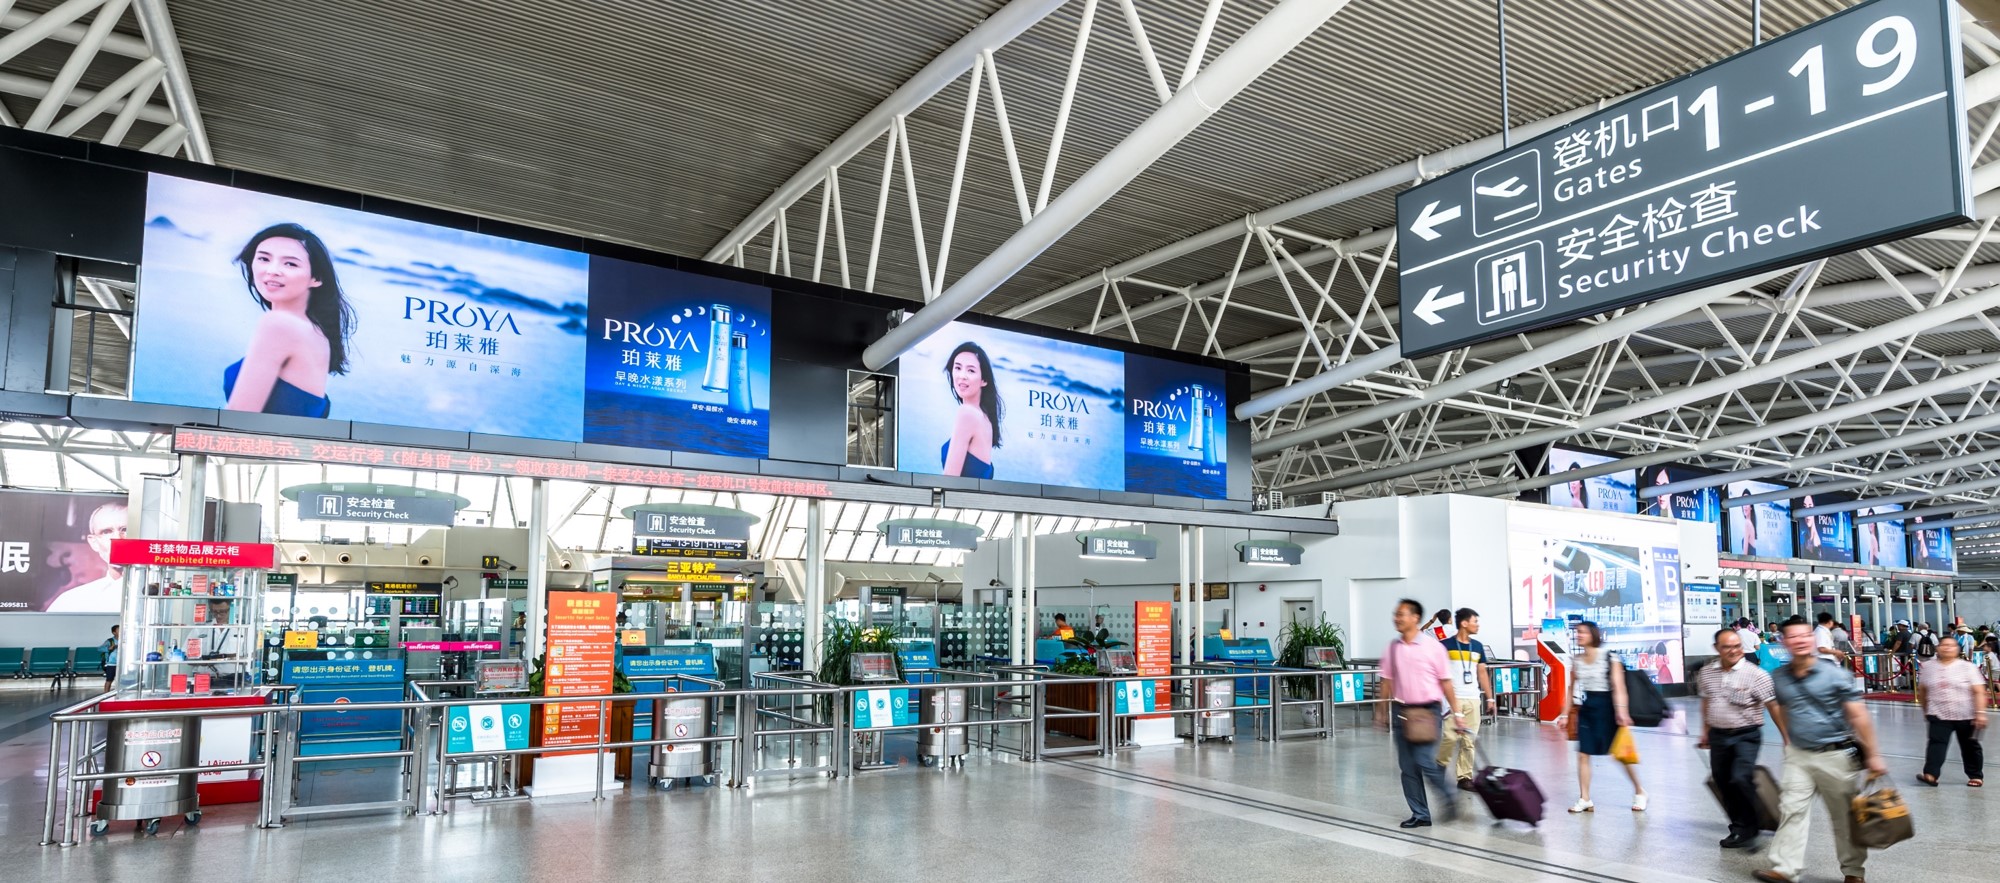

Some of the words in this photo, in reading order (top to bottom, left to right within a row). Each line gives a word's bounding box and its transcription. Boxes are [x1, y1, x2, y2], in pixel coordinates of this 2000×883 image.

[1553, 95, 1680, 176] 登机口
[1553, 158, 1643, 202] Gates
[1557, 180, 1739, 268] 安全检查
[1559, 246, 1691, 299] Security
[1701, 205, 1822, 258] Check
[402, 296, 522, 335] PROYA
[425, 330, 499, 356] 珀莱雅
[603, 318, 701, 353] PROYA
[400, 353, 521, 377] 魅力源自深海
[622, 348, 682, 372] 珀莱雅
[615, 371, 687, 390] 早晚水漾系列
[1028, 389, 1090, 415] PROYA
[1132, 398, 1187, 422] PROYA
[1040, 413, 1078, 430] 珀莱雅
[1143, 421, 1177, 437] 珀莱雅
[1597, 487, 1623, 501] PROYA
[346, 496, 396, 510] 安全检查
[1675, 495, 1700, 510] PROYA
[346, 509, 381, 519] Security
[383, 510, 409, 520] Check
[669, 515, 706, 527] 安全检查
[669, 526, 695, 535] Security
[696, 527, 716, 535] Check
[915, 528, 943, 538] 安全检查
[148, 543, 240, 556] 违禁物品展示柜
[915, 537, 935, 546] Security
[935, 538, 951, 546] Check
[1106, 539, 1129, 548] 安全检查
[0, 541, 30, 574] 民
[1106, 547, 1122, 555] Security
[154, 555, 204, 564] Prohibited
[205, 556, 231, 565] Items
[667, 561, 716, 574] 三亚特产
